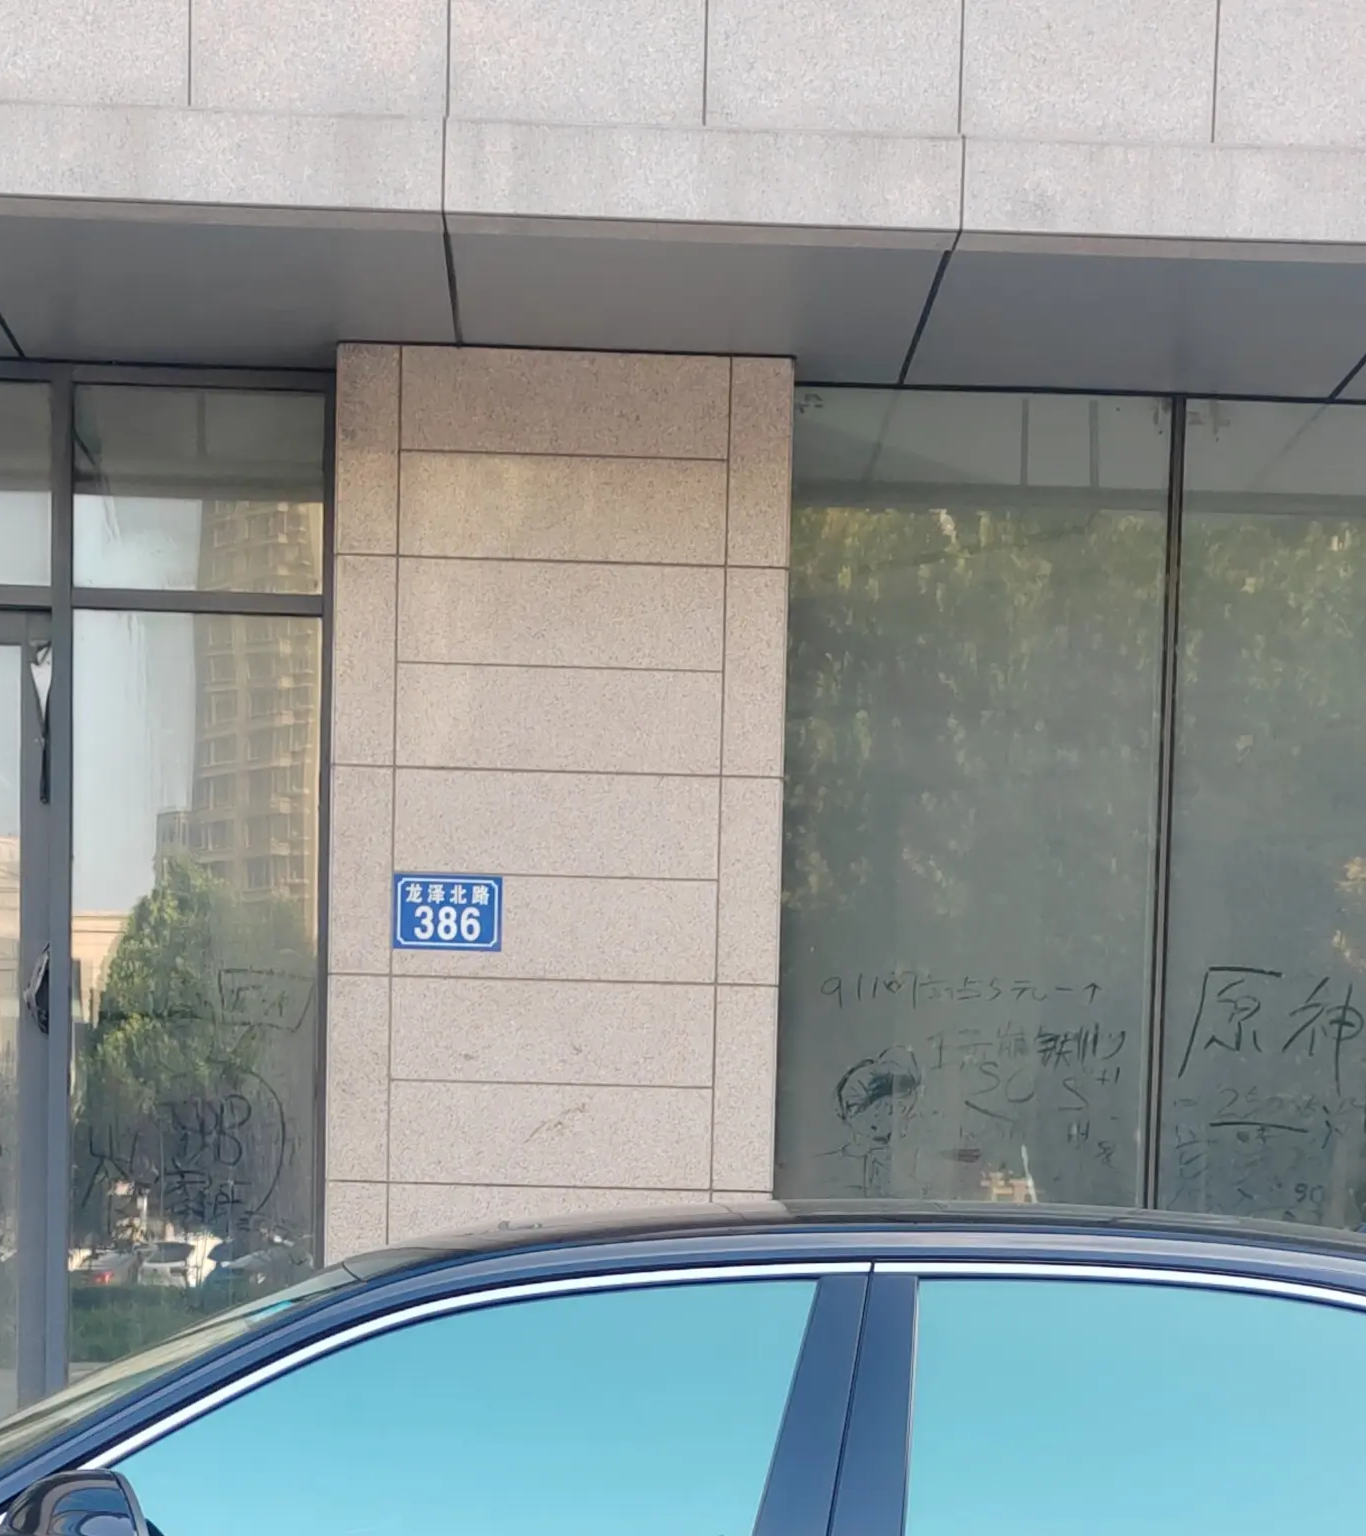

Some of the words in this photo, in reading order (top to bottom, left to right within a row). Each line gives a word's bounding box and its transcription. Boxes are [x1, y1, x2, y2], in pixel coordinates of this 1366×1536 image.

[405, 883, 490, 905] 龙泽北路
[414, 905, 481, 941] 386
